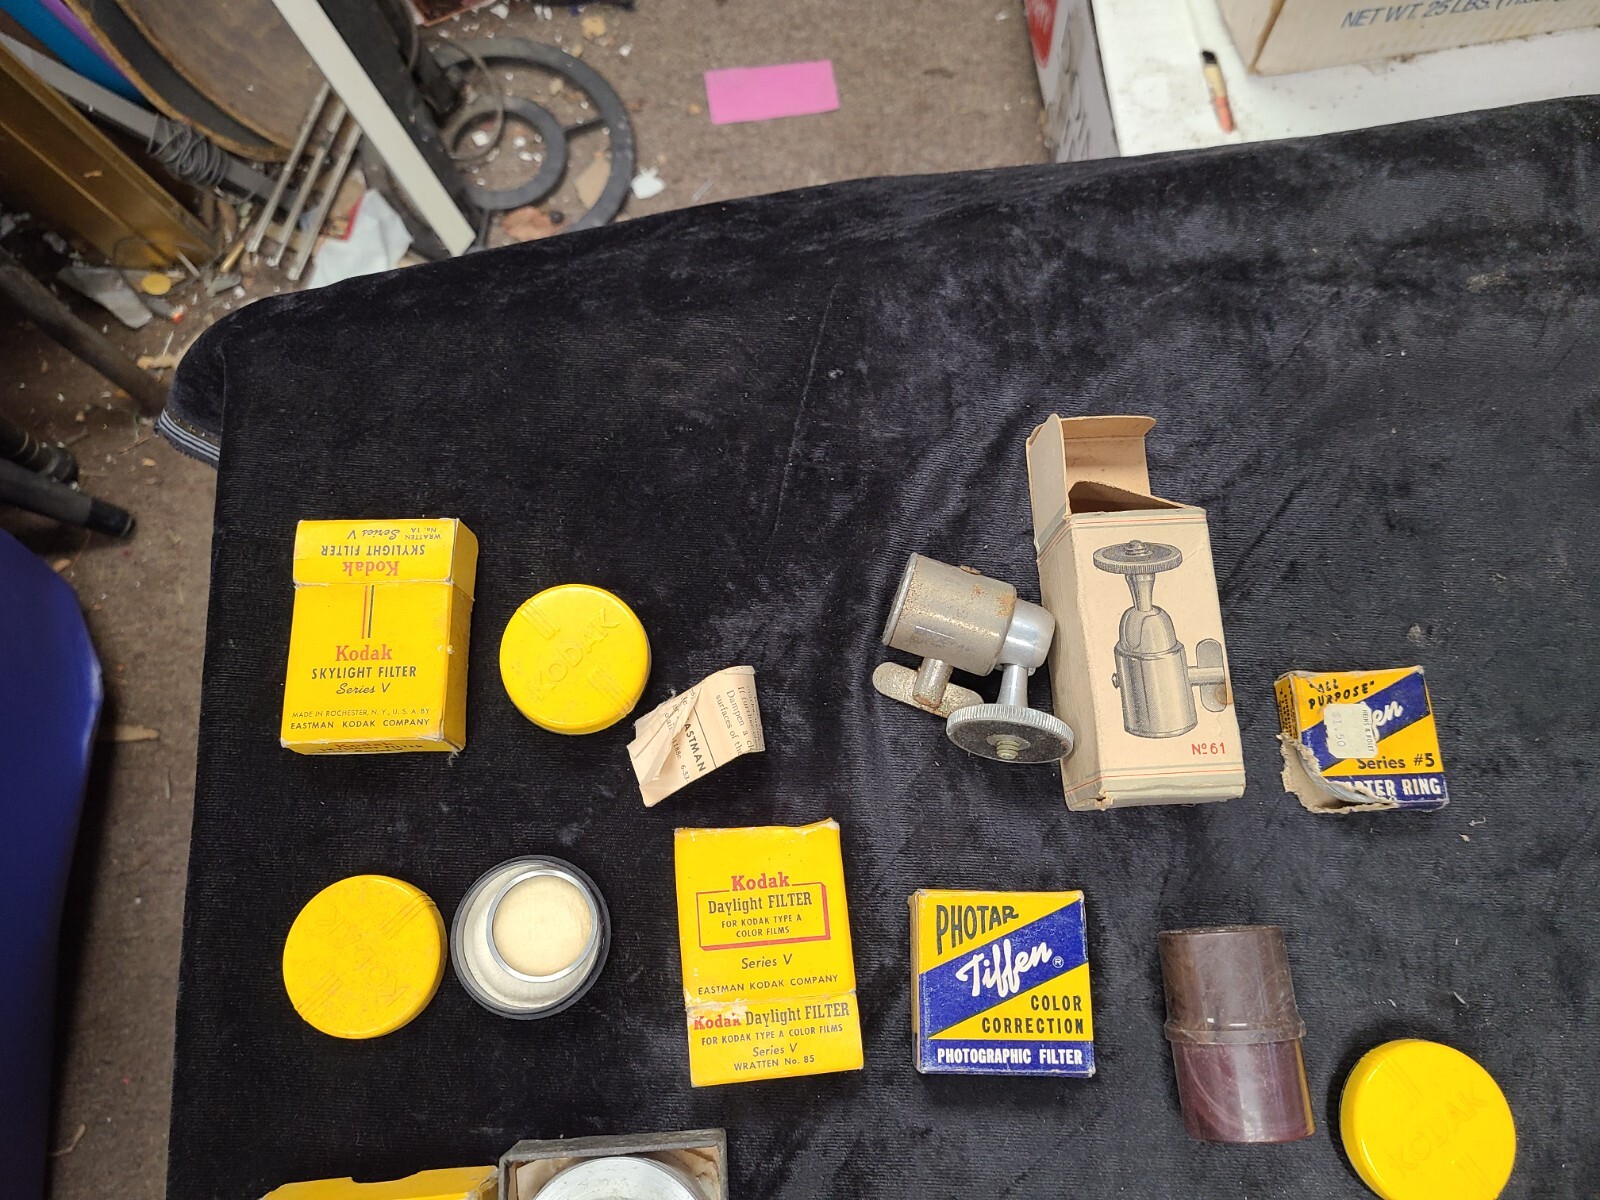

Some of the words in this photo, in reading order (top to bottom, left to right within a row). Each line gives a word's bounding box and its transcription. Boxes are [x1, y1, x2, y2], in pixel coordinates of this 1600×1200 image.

[1341, 8, 1385, 28] NET
[1423, 0, 1449, 18] 25
[347, 530, 356, 540] V
[361, 529, 401, 540] Series
[321, 545, 361, 556] FILTER
[366, 544, 425, 556] SKYLIGHT
[342, 560, 400, 576] Kodak
[335, 644, 393, 662] Kodak
[526, 607, 620, 701] KODAK
[311, 666, 373, 680] SKYLIGHT
[378, 666, 417, 678] FILTER
[336, 682, 375, 694] Series
[381, 682, 391, 693] V
[715, 694, 732, 729] surfaces
[730, 731, 739, 739] of
[726, 689, 745, 727] Dampen
[290, 722, 334, 730] EASTMAN
[342, 720, 376, 728] KODAK
[383, 719, 430, 727] COMPANY
[684, 717, 707, 772] ASTMAN
[1358, 756, 1406, 769] Series
[1402, 778, 1442, 796] RING
[731, 872, 790, 892] Kodak
[707, 896, 763, 916] Daylight
[768, 891, 813, 908] FILTER
[721, 919, 737, 929] FOR
[741, 917, 770, 927] KODAK
[773, 914, 793, 924] TYPE
[796, 914, 802, 922] A
[935, 904, 1019, 956] PHOTAR
[736, 927, 763, 938] COLOR
[766, 926, 790, 936] FILMS
[741, 956, 778, 970] Series
[783, 953, 793, 965] V
[698, 983, 745, 995] EASTMAN
[749, 979, 785, 990] KODAK
[790, 974, 839, 987] COMPANY
[1031, 994, 1083, 1011] COLOR
[693, 1012, 742, 1031] Kodak
[745, 1006, 802, 1028] Daylight
[804, 1002, 850, 1020] FILTER
[981, 1017, 1084, 1034] CORRECTION
[701, 1037, 718, 1046] FOR
[721, 1033, 752, 1044] KODAK
[755, 1030, 775, 1040] TYPE
[779, 1030, 785, 1038] A
[788, 1026, 816, 1037] COLOR
[819, 1024, 843, 1034] FILMS
[752, 1045, 785, 1058] Series
[789, 1042, 798, 1053] V
[937, 1048, 1032, 1064] PHOTOGRAPHIC
[1039, 1048, 1083, 1065] FILTER
[733, 1059, 779, 1071] WRATTEN
[784, 1057, 800, 1066] No.
[803, 1055, 815, 1064] 85
